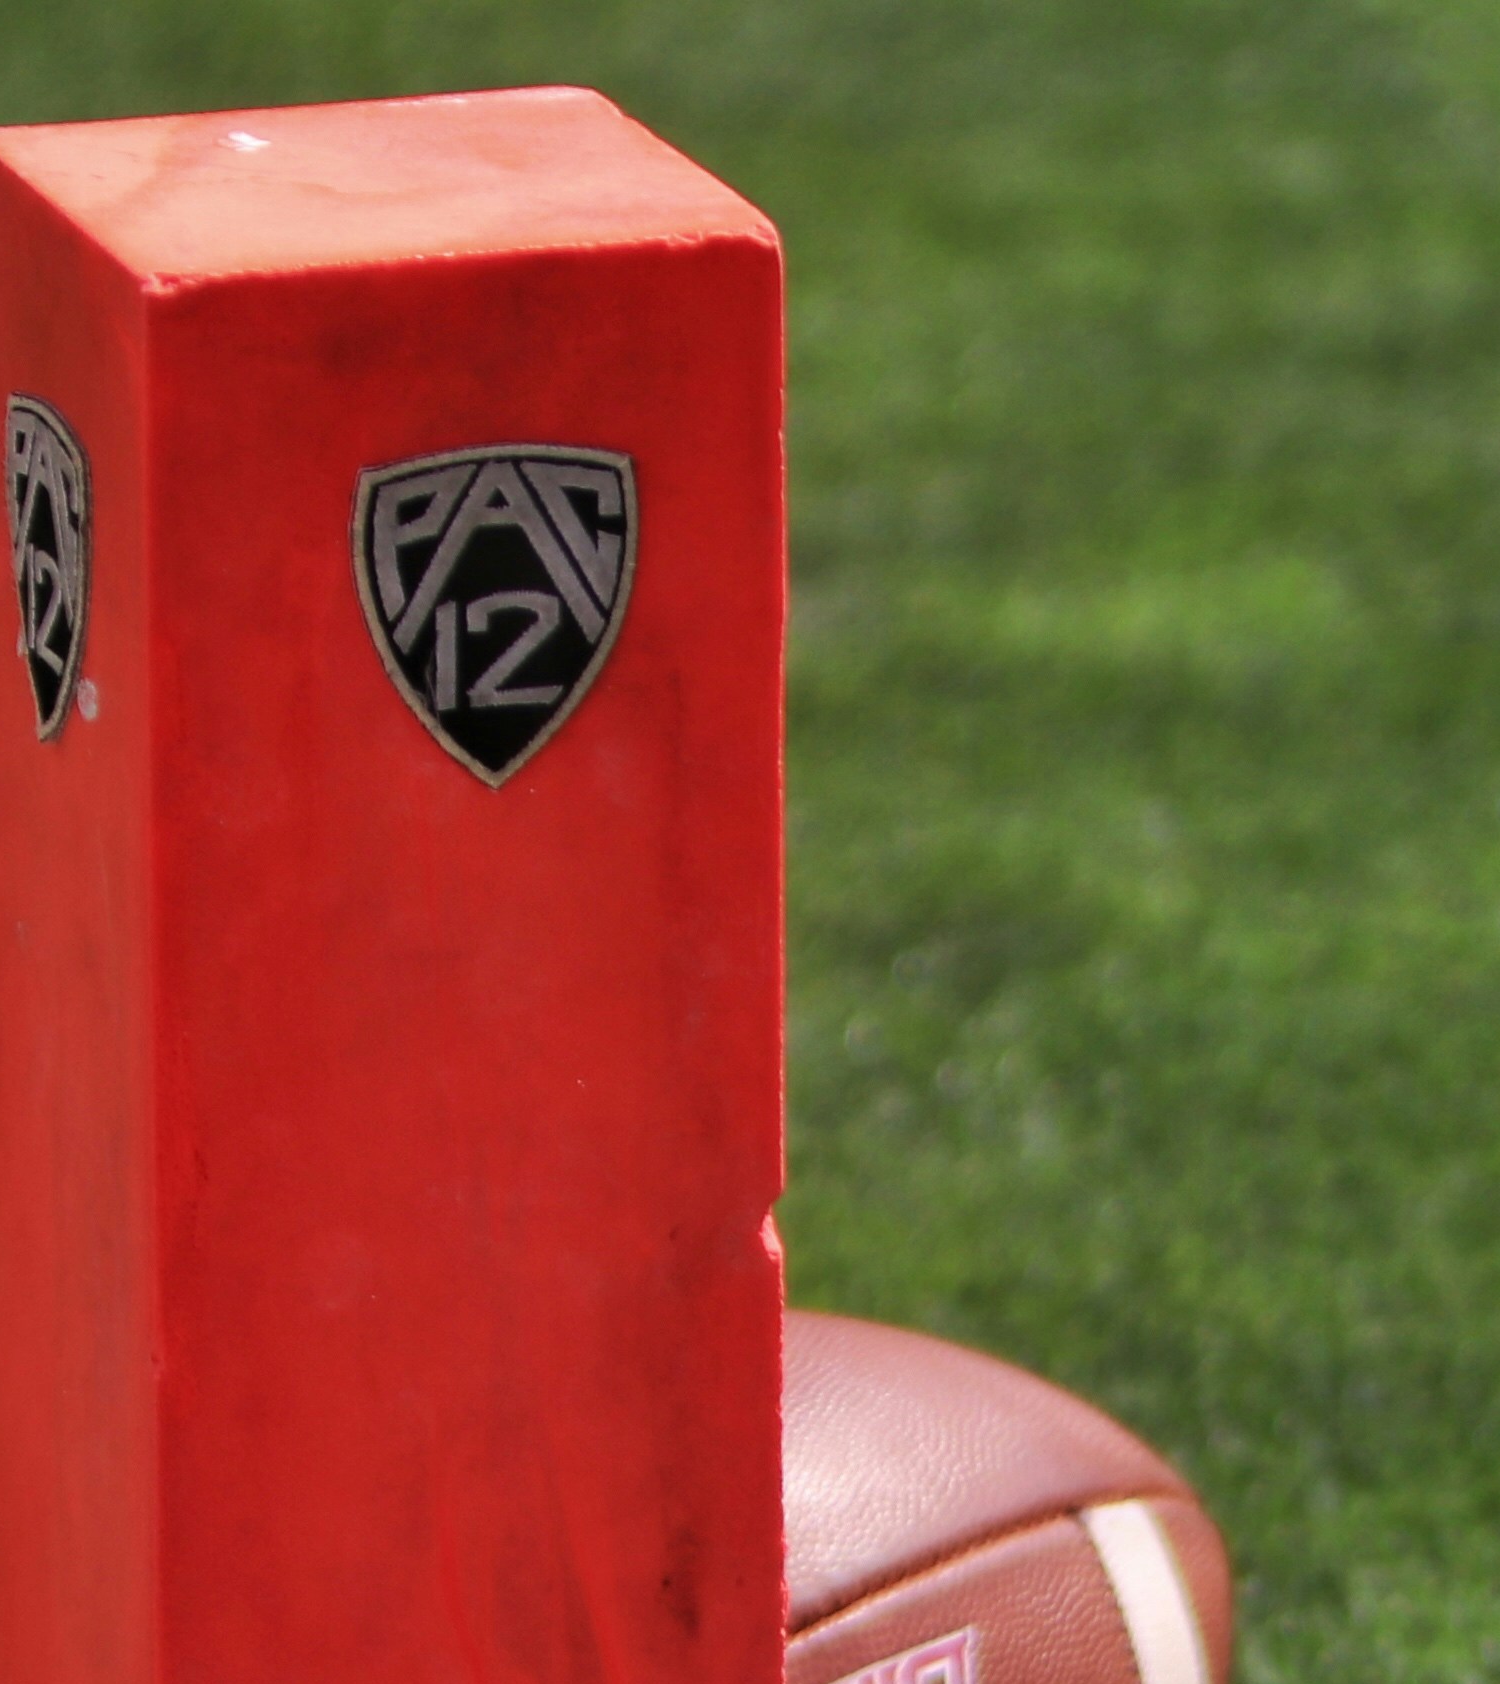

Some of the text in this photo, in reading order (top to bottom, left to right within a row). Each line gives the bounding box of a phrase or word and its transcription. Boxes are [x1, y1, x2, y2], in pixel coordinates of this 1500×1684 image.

[26, 542, 64, 678] 12
[374, 460, 622, 655] PAC
[431, 589, 564, 712] 12
